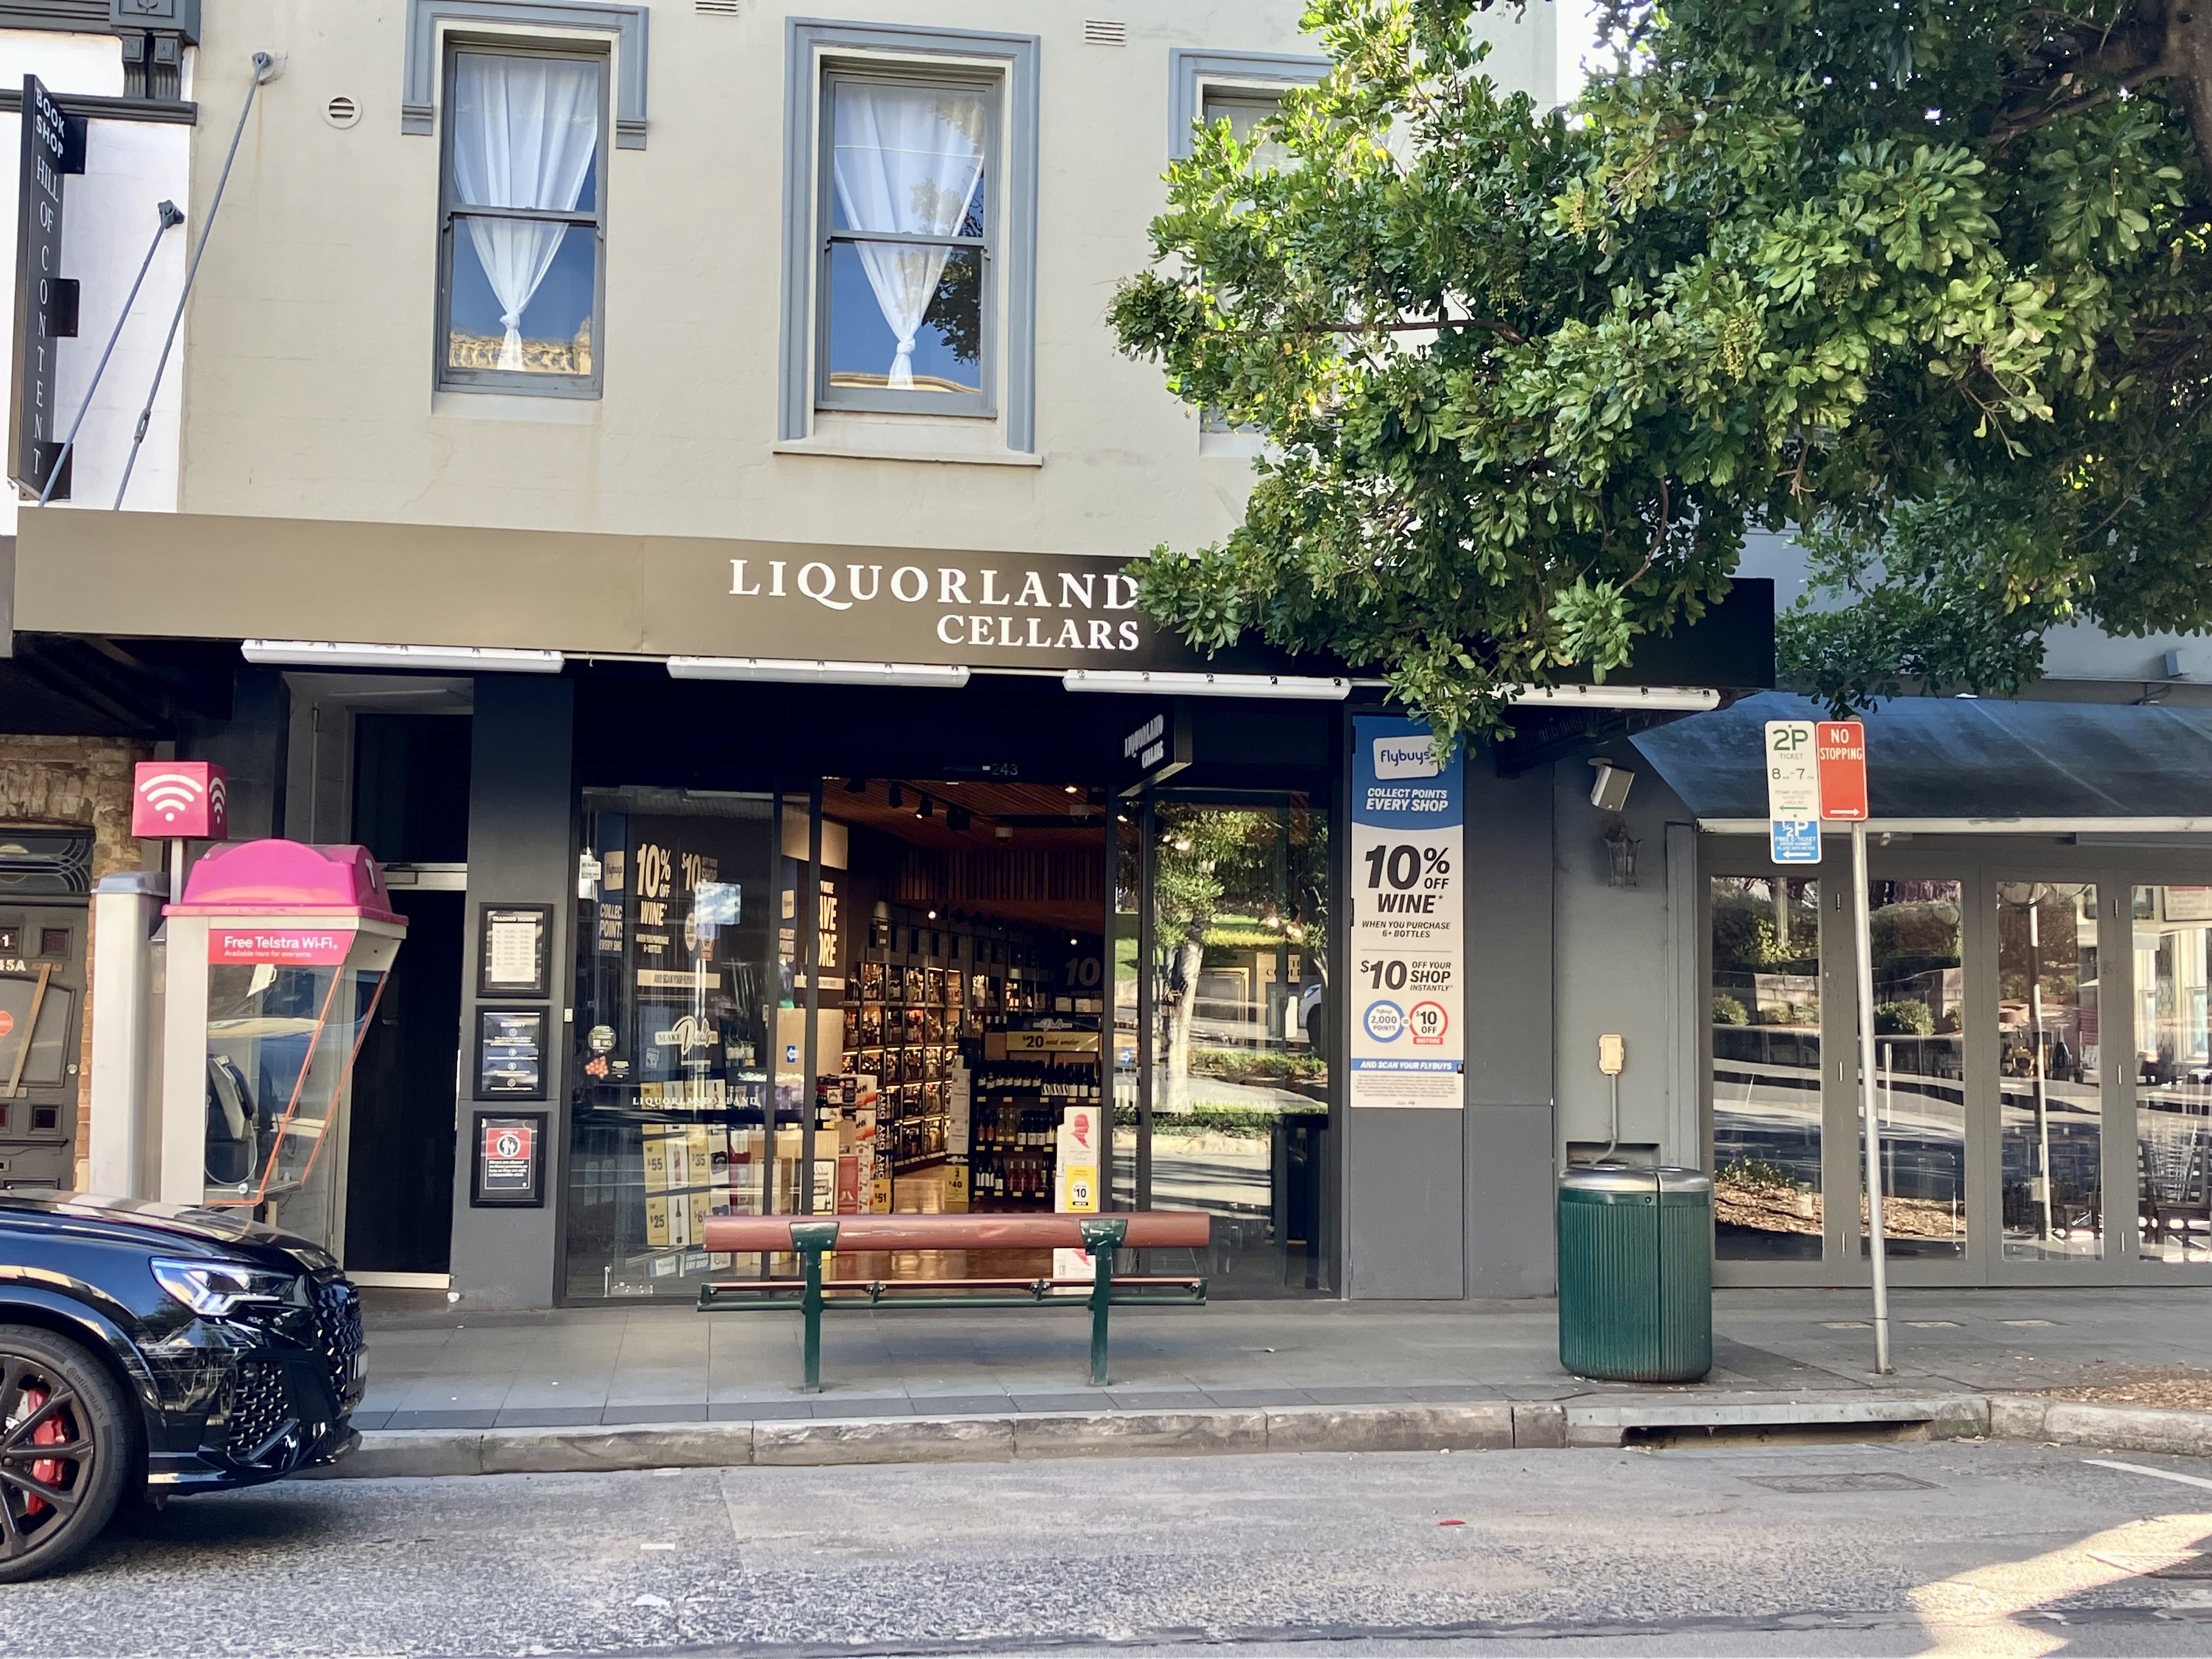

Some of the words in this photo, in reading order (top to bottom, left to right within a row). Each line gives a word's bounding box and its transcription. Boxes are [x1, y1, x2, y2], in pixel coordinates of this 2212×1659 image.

[36, 87, 65, 138] BOOK
[36, 114, 64, 159] SHOP
[37, 154, 59, 202] HILL
[40, 201, 54, 233] OF
[33, 245, 49, 475] CONTENT
[729, 558, 1139, 611] LIQUORLAND
[936, 614, 1139, 651] CELLARS
[1773, 729, 1808, 751] 2P
[1831, 729, 1849, 744] NO
[1380, 749, 1430, 767] flybuys
[1820, 747, 1863, 760] STOPPING
[991, 763, 1018, 775] 243
[1367, 788, 1410, 798] COLLECT
[1412, 789, 1447, 799] POINTS
[1366, 798, 1410, 811] EVERY
[1410, 800, 1448, 812] SHOP
[637, 844, 672, 898] 10%
[681, 852, 702, 893] $10
[1365, 845, 1450, 890] 10%
[1424, 878, 1449, 889] OFF
[659, 883, 670, 898] OFF
[1362, 921, 1386, 929] WHEN
[1389, 921, 1404, 929] YOU
[1393, 930, 1430, 938] BOTTLES
[2, 935, 9, 947] 1
[224, 936, 252, 949] Free
[255, 936, 300, 949] Telstra
[1065, 957, 1101, 986] 10
[1360, 960, 1407, 990] $10
[1410, 970, 1451, 983] SHOP
[1371, 1015, 1397, 1024] 2,000
[1416, 1011, 1437, 1025] $10
[1421, 1026, 1437, 1034] OFF
[658, 1034, 682, 1042] MAKE
[1023, 1035, 1045, 1048] $20
[1400, 1062, 1420, 1070] YOUR
[647, 1158, 663, 1171] $55
[692, 1153, 706, 1166] $35
[874, 1193, 887, 1203] $51
[1074, 1188, 1087, 1198] $10
[650, 1215, 665, 1228] $25
